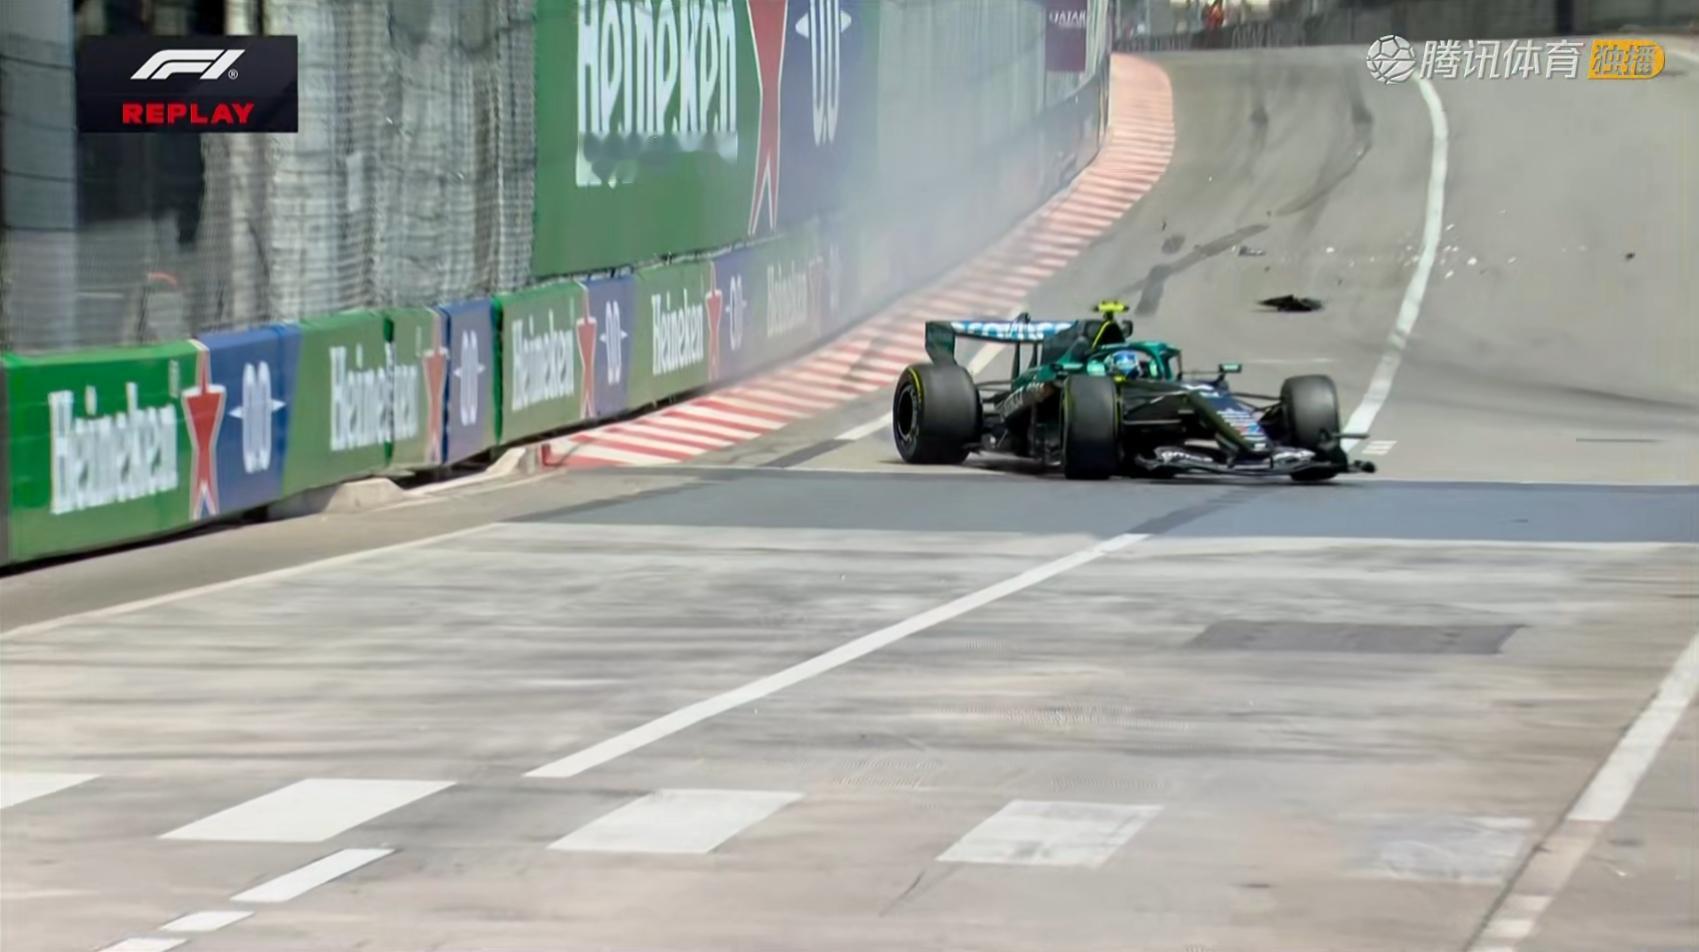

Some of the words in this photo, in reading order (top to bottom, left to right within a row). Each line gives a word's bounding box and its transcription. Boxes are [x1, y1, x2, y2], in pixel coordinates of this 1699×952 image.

[512, 308, 574, 412] Heineken
[651, 287, 704, 376] Heineken
[48, 381, 178, 515] Heineken
